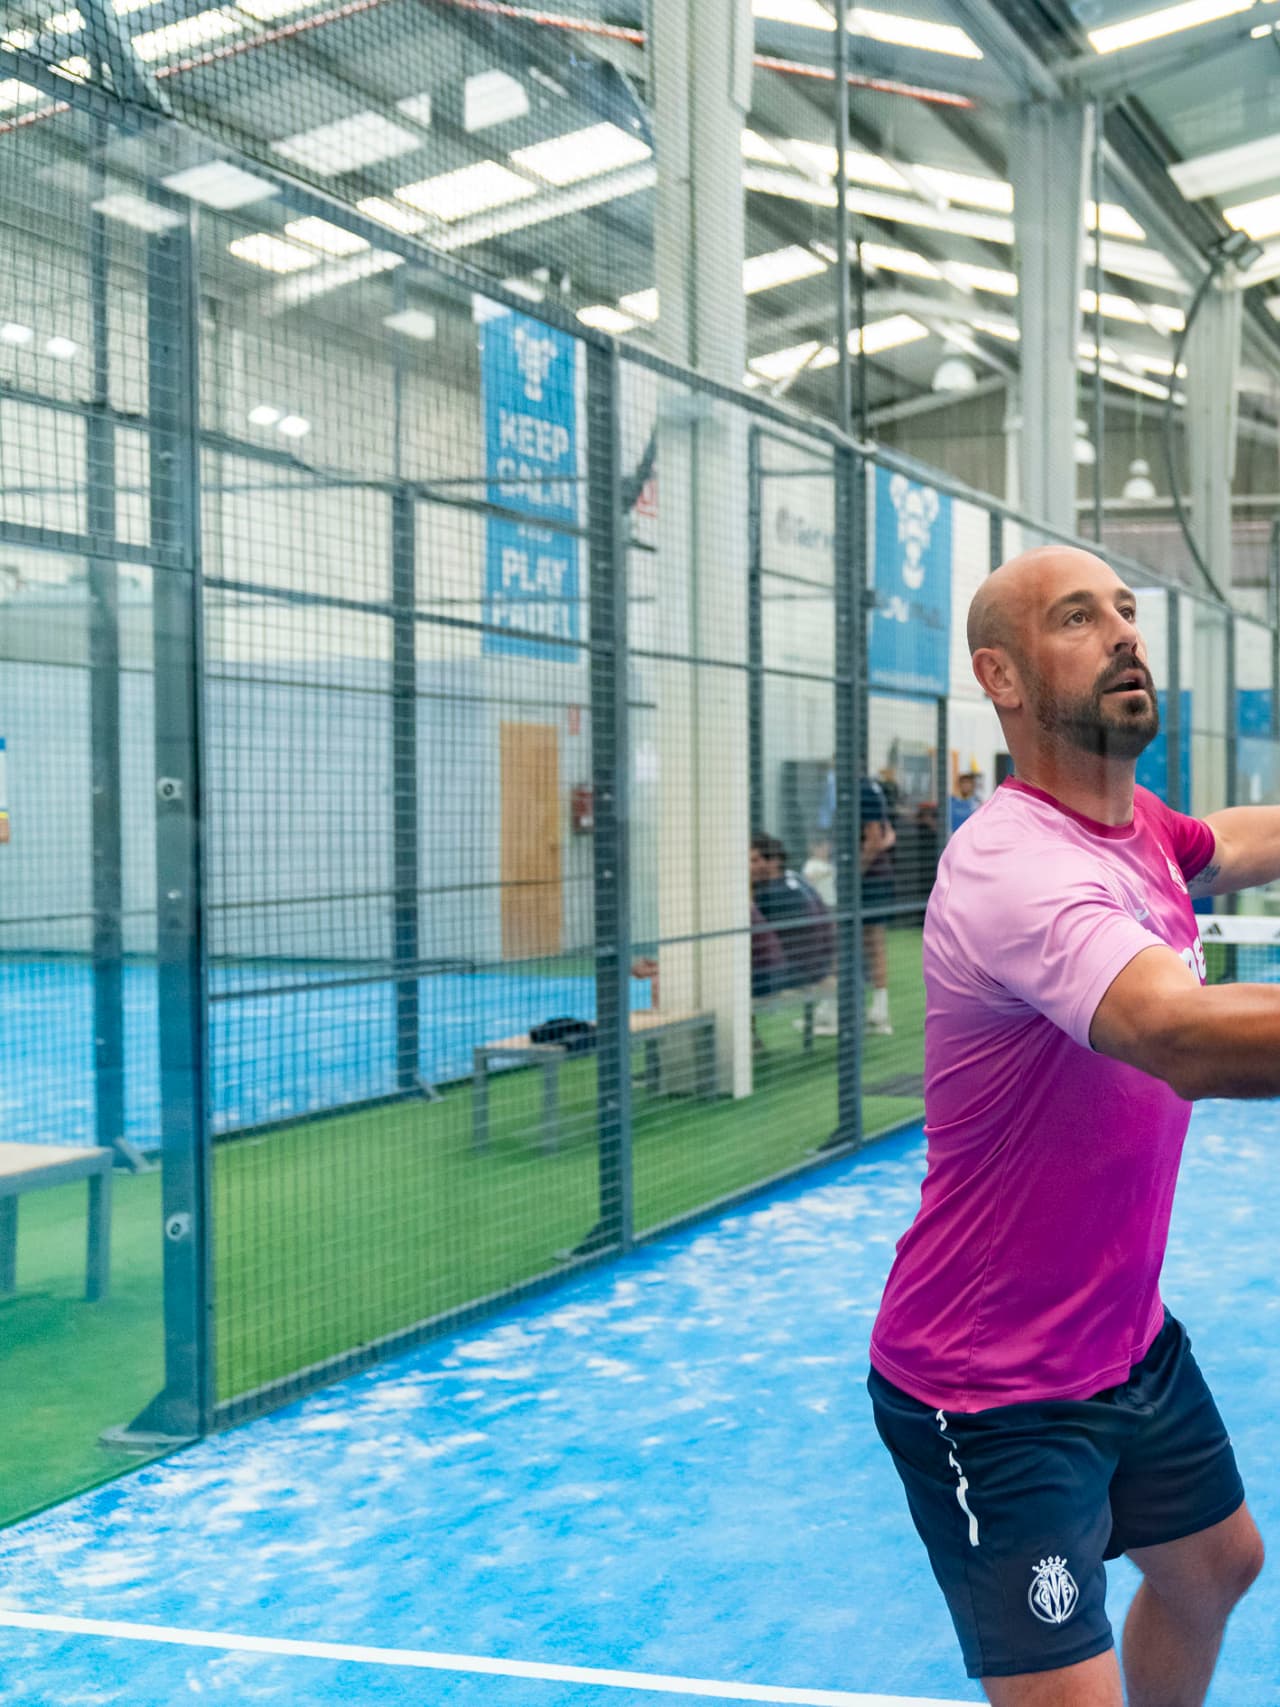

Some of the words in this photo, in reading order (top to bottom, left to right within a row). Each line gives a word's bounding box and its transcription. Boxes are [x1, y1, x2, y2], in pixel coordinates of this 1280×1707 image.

[499, 407, 569, 462] KEEP
[496, 456, 570, 509] CALM
[501, 545, 569, 599] PLAY
